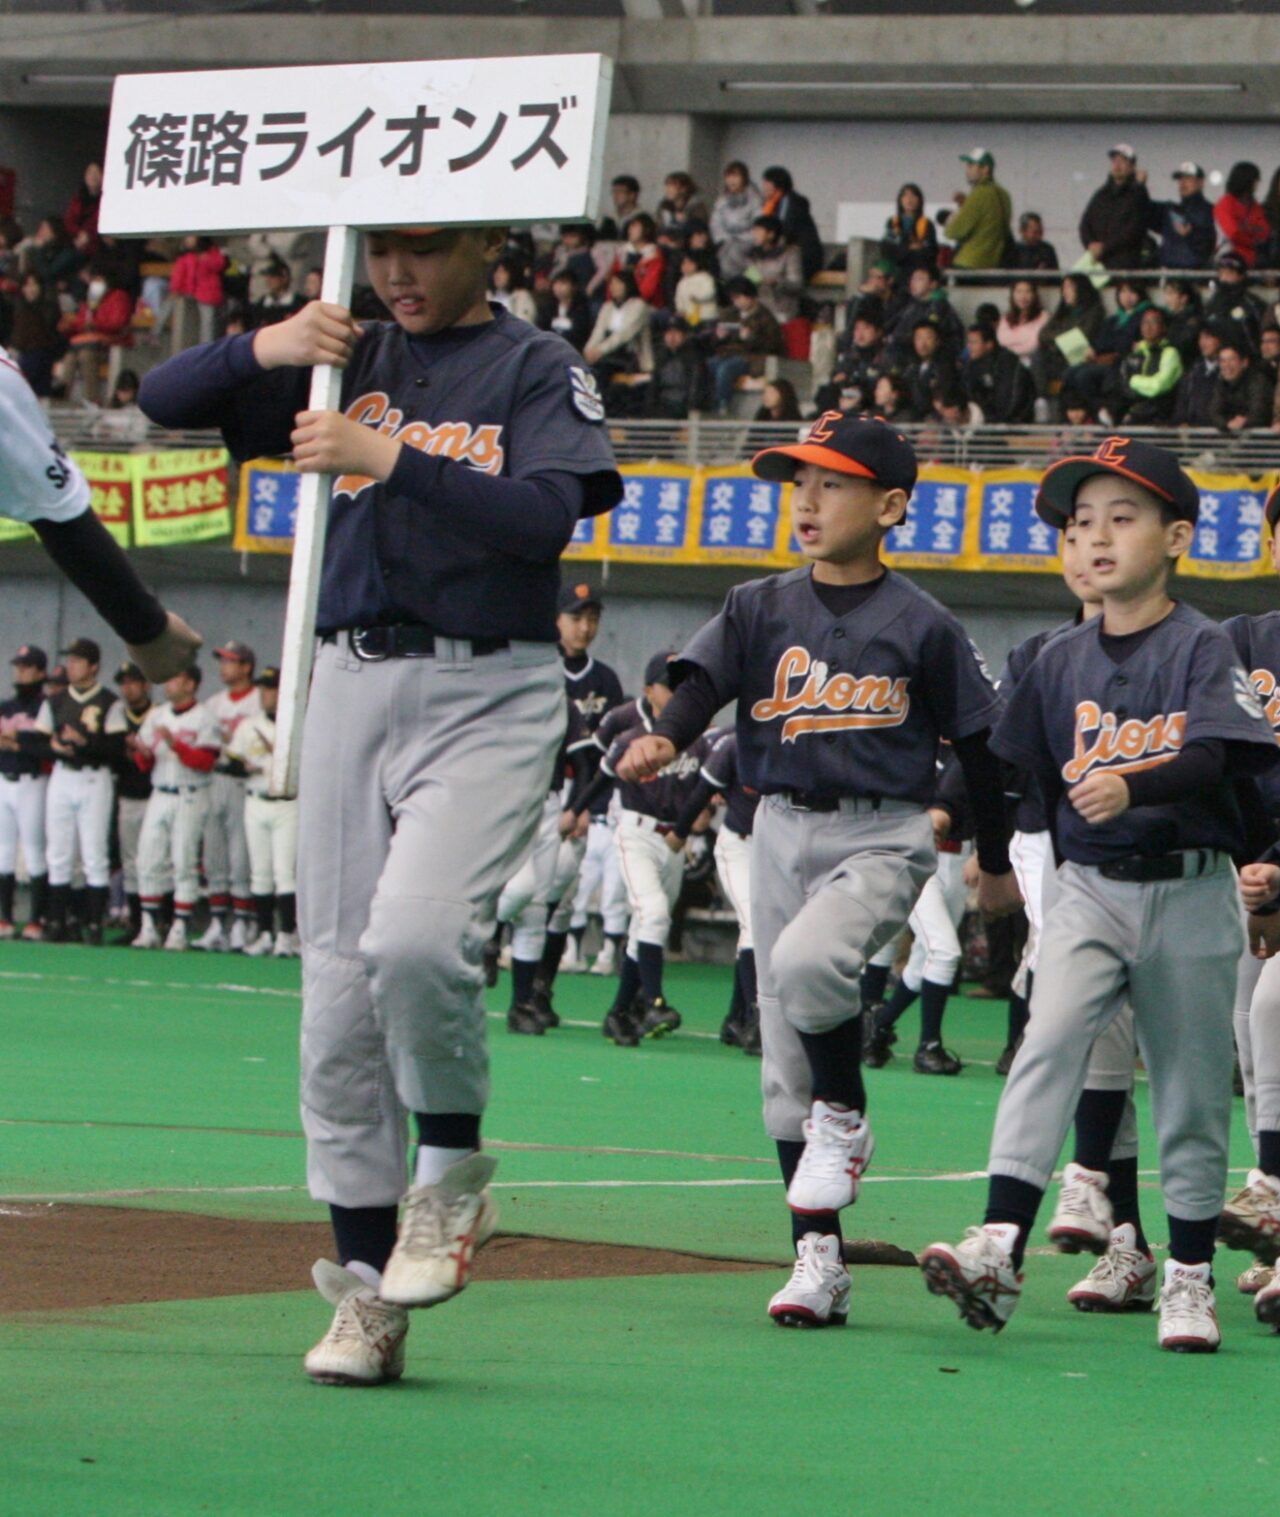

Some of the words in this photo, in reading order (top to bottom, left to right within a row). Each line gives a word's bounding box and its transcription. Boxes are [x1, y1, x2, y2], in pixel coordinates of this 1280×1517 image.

[124, 95, 579, 190] 篠路ライオンズ
[711, 482, 772, 515] 交通
[1199, 494, 1261, 525] 交通
[617, 512, 678, 542] 安全
[708, 514, 768, 545] 安全
[988, 520, 1050, 551] 安全
[1198, 527, 1261, 558] 安全
[751, 646, 910, 740] Lions
